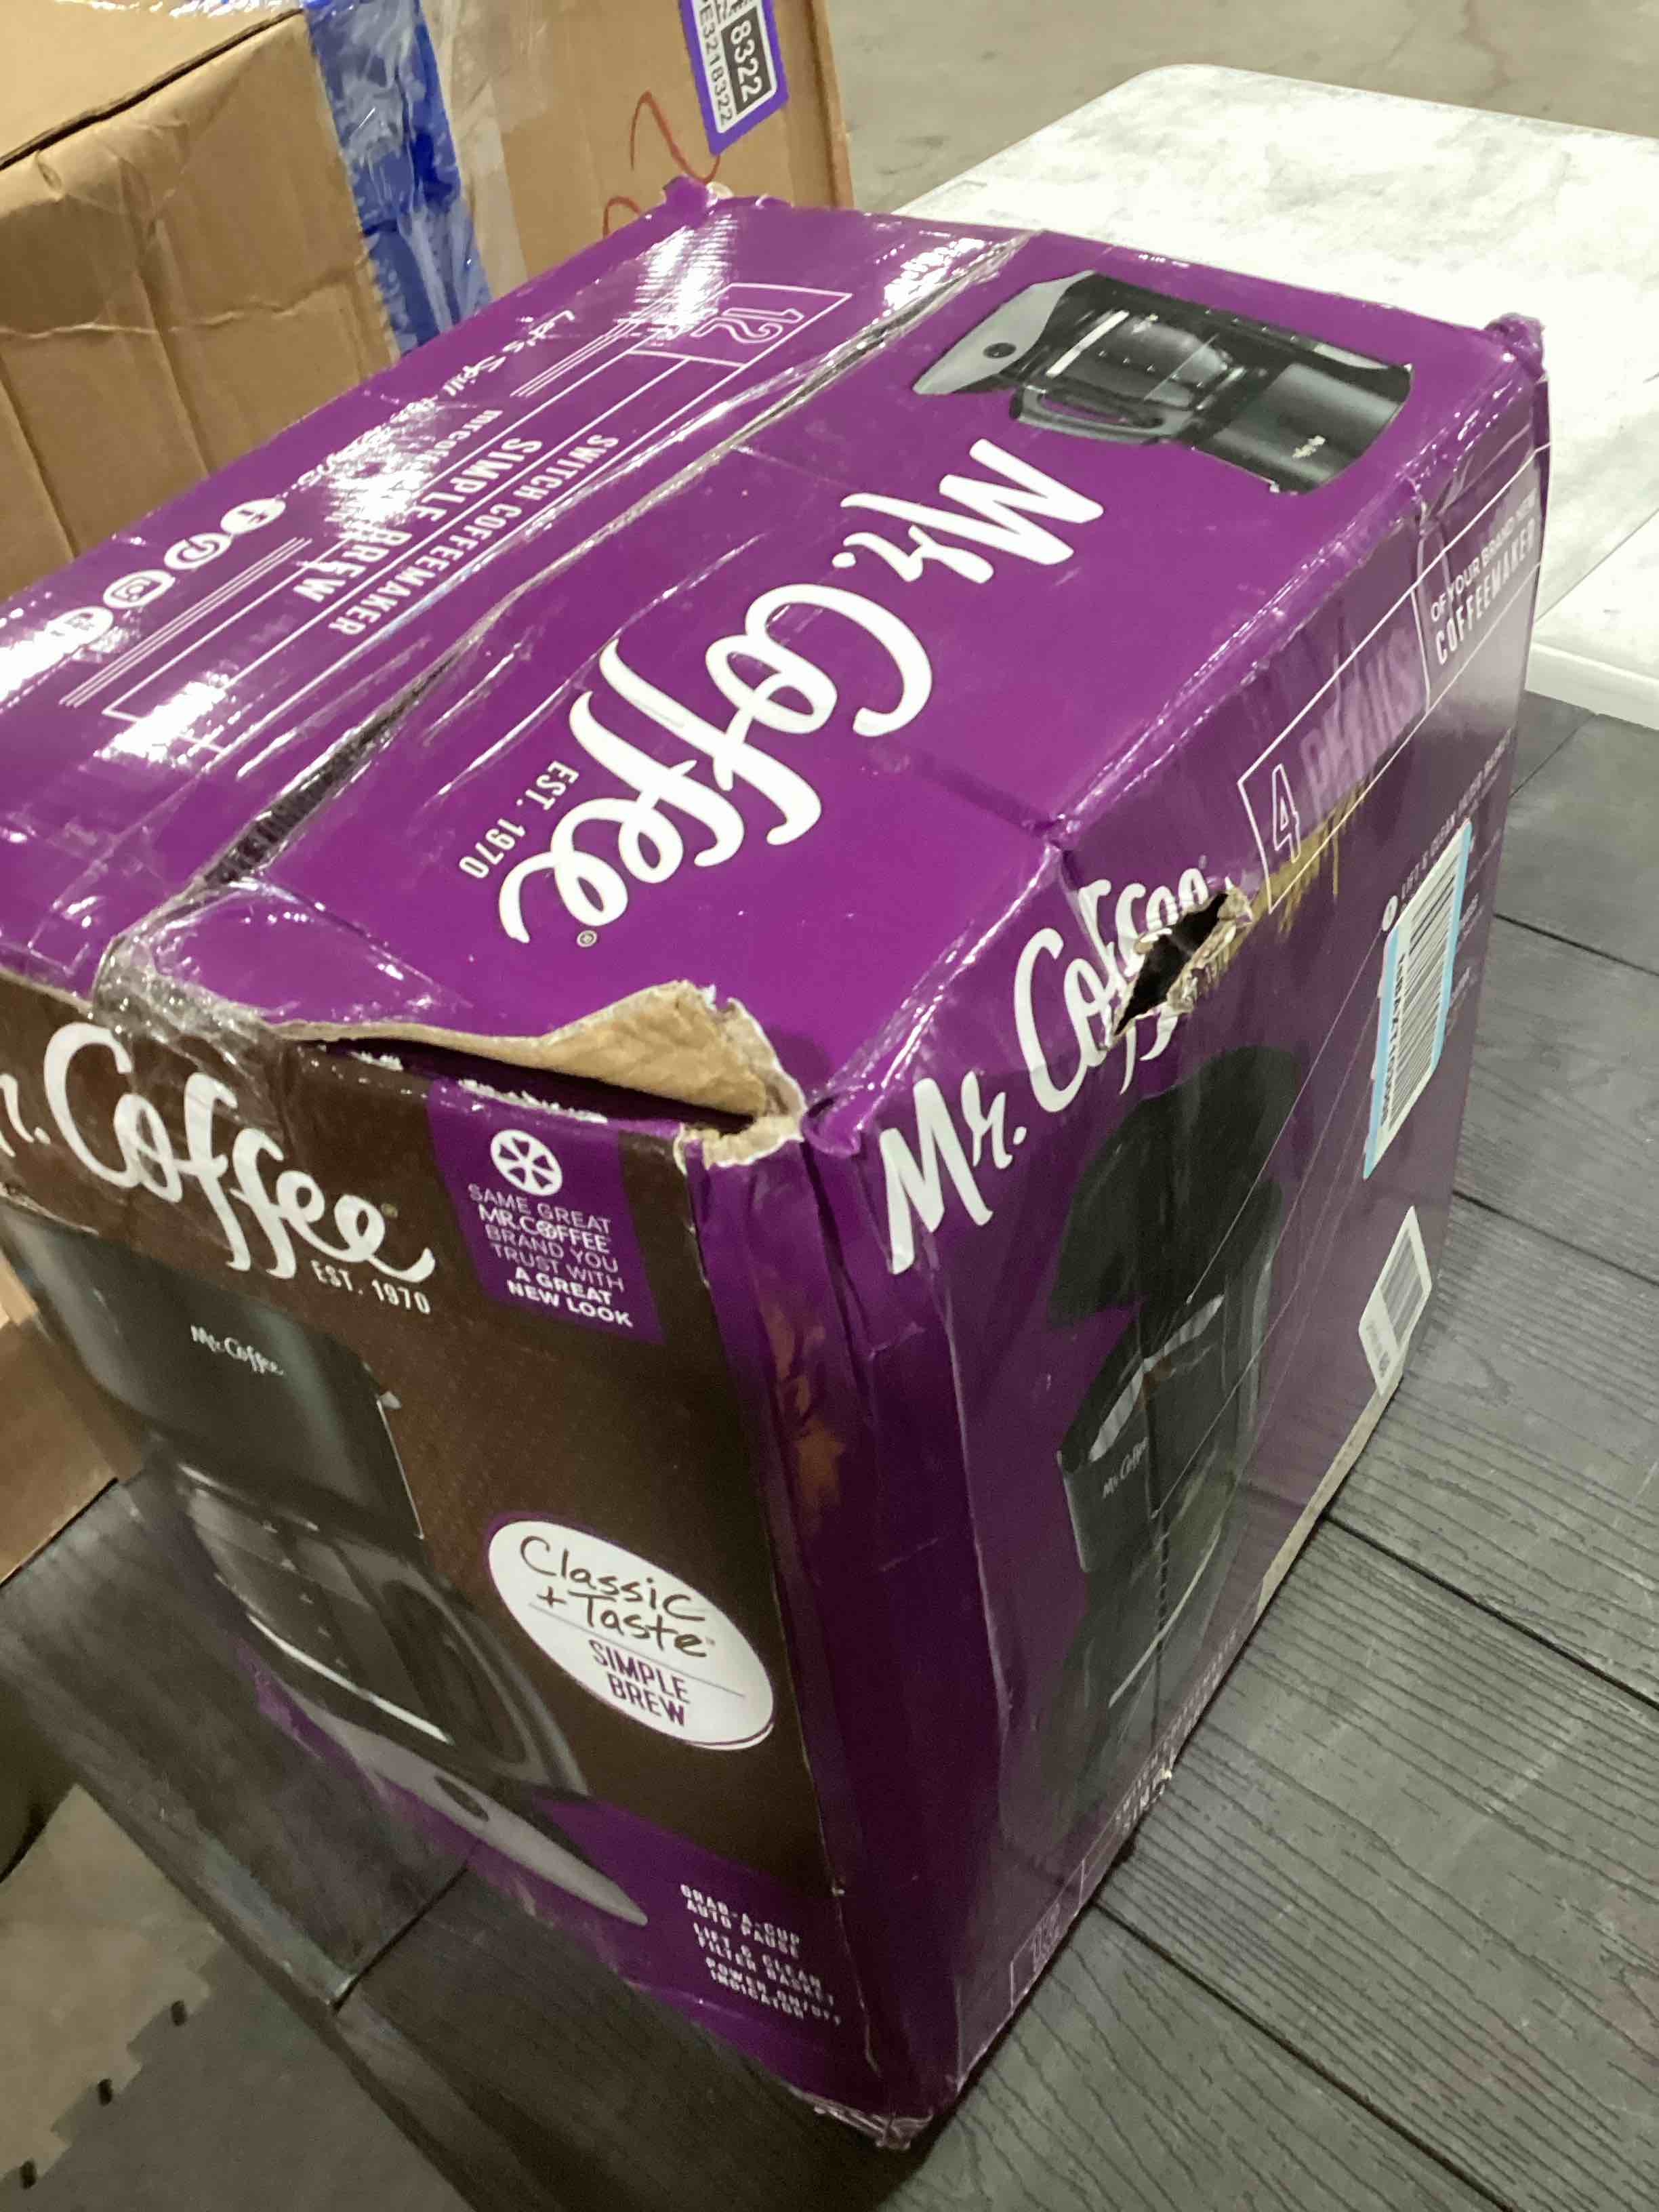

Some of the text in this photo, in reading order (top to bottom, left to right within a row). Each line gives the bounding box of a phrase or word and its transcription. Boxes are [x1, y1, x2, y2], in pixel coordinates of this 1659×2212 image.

[731, 20, 762, 102] 8322
[691, 308, 804, 344] 12
[293, 437, 543, 602] SIMPLE BREW
[328, 434, 620, 637] SWITCH COFFEEMAKER
[832, 438, 1105, 584] Mr.
[1434, 517, 1536, 665] COFFEEMAKER
[1447, 556, 1481, 603] YOUR
[499, 583, 933, 944] Coffee
[457, 758, 580, 881] EST. 1970
[1271, 763, 1302, 865] 4
[43, 1021, 436, 1282] Coffee
[879, 1070, 1027, 1275] Mr.
[468, 1183, 611, 1234] SAME GREAT
[485, 1224, 619, 1273] BRAND YOU
[490, 1242, 624, 1293] TRUST WITH
[515, 1266, 612, 1305] A GREAT
[310, 1260, 430, 1316] EST. 1970
[506, 1279, 634, 1328] NEW LOOK
[519, 1534, 706, 1622] Classic
[537, 1585, 708, 1659] + Taste
[588, 1639, 690, 1705] SIMPLE
[607, 1673, 687, 1728] BREW
